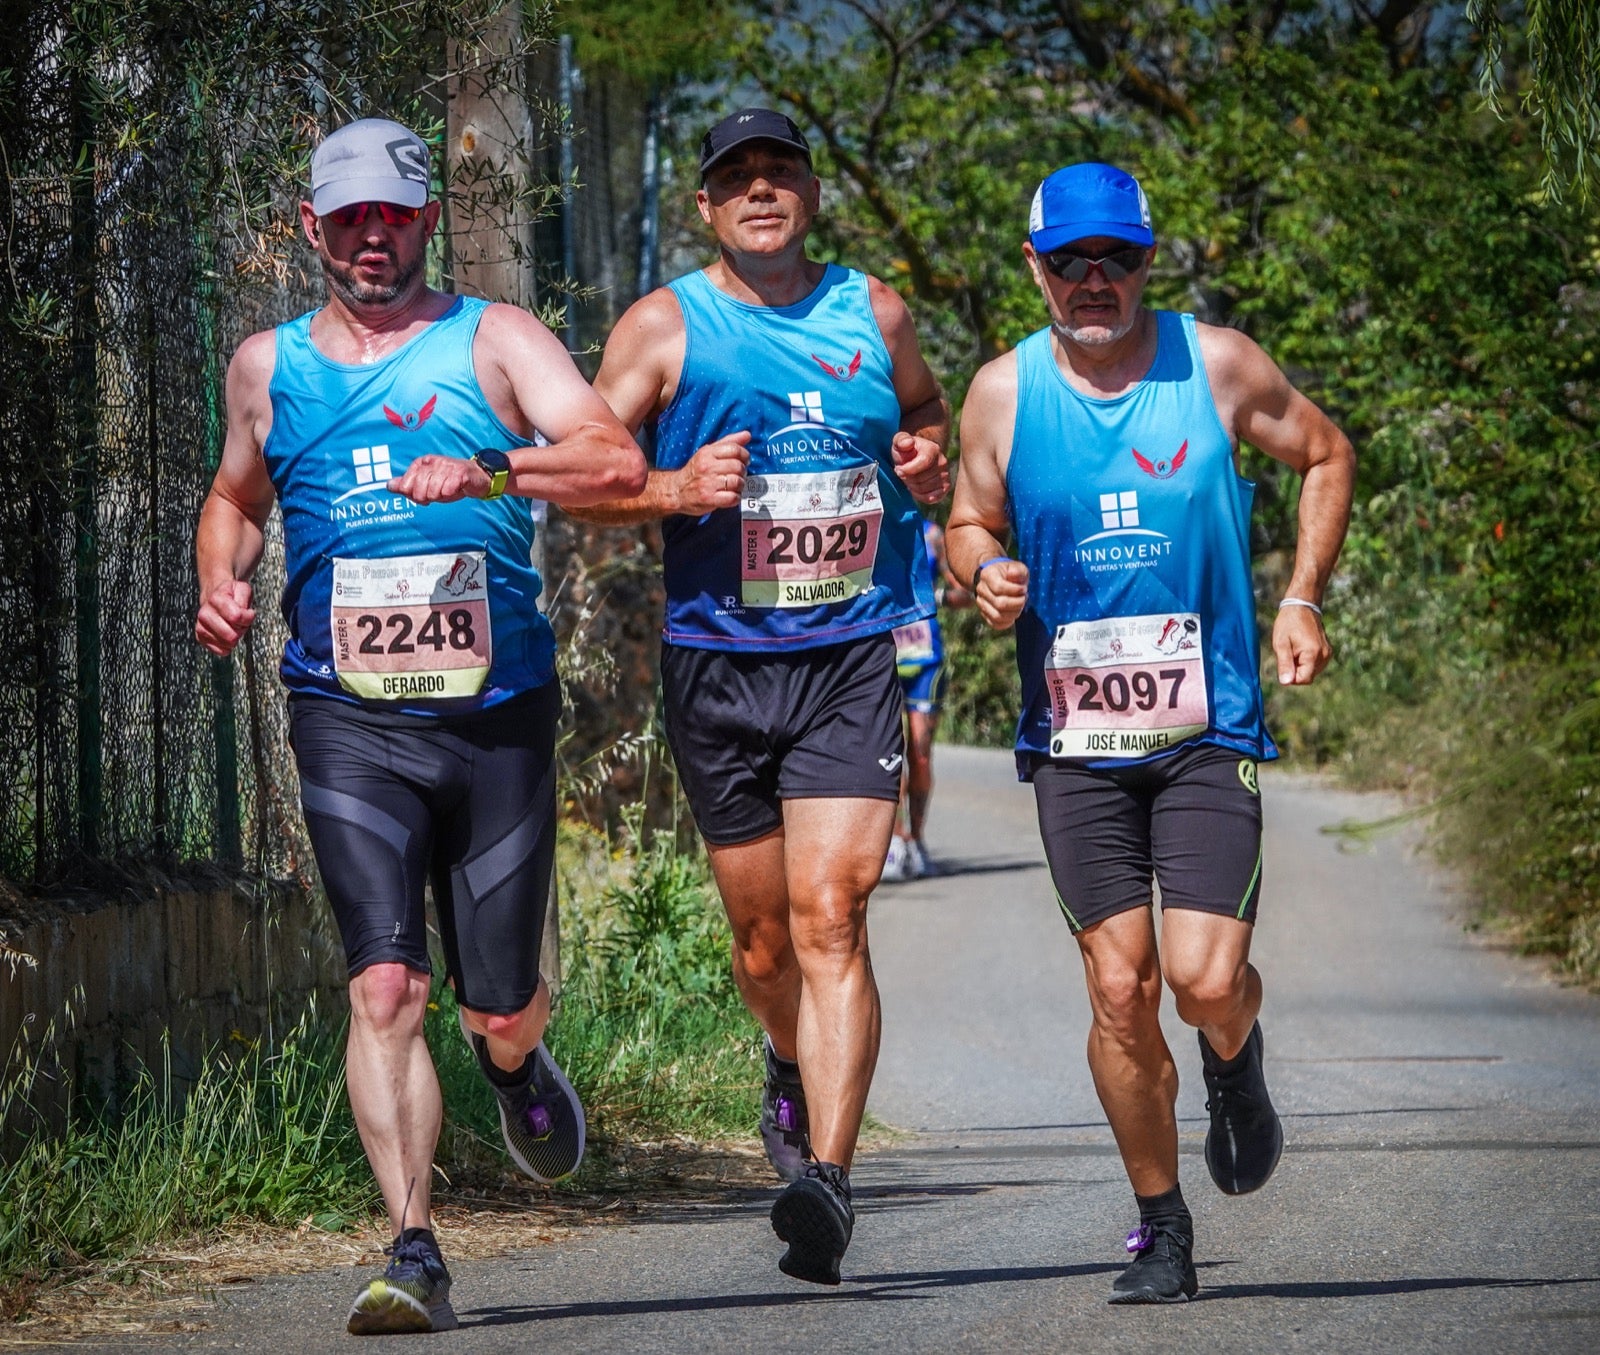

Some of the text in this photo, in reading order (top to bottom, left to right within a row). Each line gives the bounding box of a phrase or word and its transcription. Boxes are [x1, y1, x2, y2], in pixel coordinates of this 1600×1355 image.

[780, 455, 805, 464] PUERTAS
[330, 497, 417, 522] INNOVEN
[345, 517, 373, 529] PUERTAS
[380, 511, 415, 522] VENTANAS
[767, 519, 868, 564] 2029
[1075, 542, 1172, 563] INNOVENT
[747, 537, 757, 570] MASTER
[1090, 564, 1117, 572] PUERTAS
[1124, 560, 1158, 570] VENTANAS
[786, 580, 845, 601] SALVADOR
[357, 609, 475, 654] 2248
[338, 626, 349, 661] MASTER
[384, 675, 445, 694] GERARDO
[1074, 668, 1186, 712] 2097
[1055, 687, 1069, 718] MASTER
[1086, 731, 1171, 751] JOSÉ MANUEL
